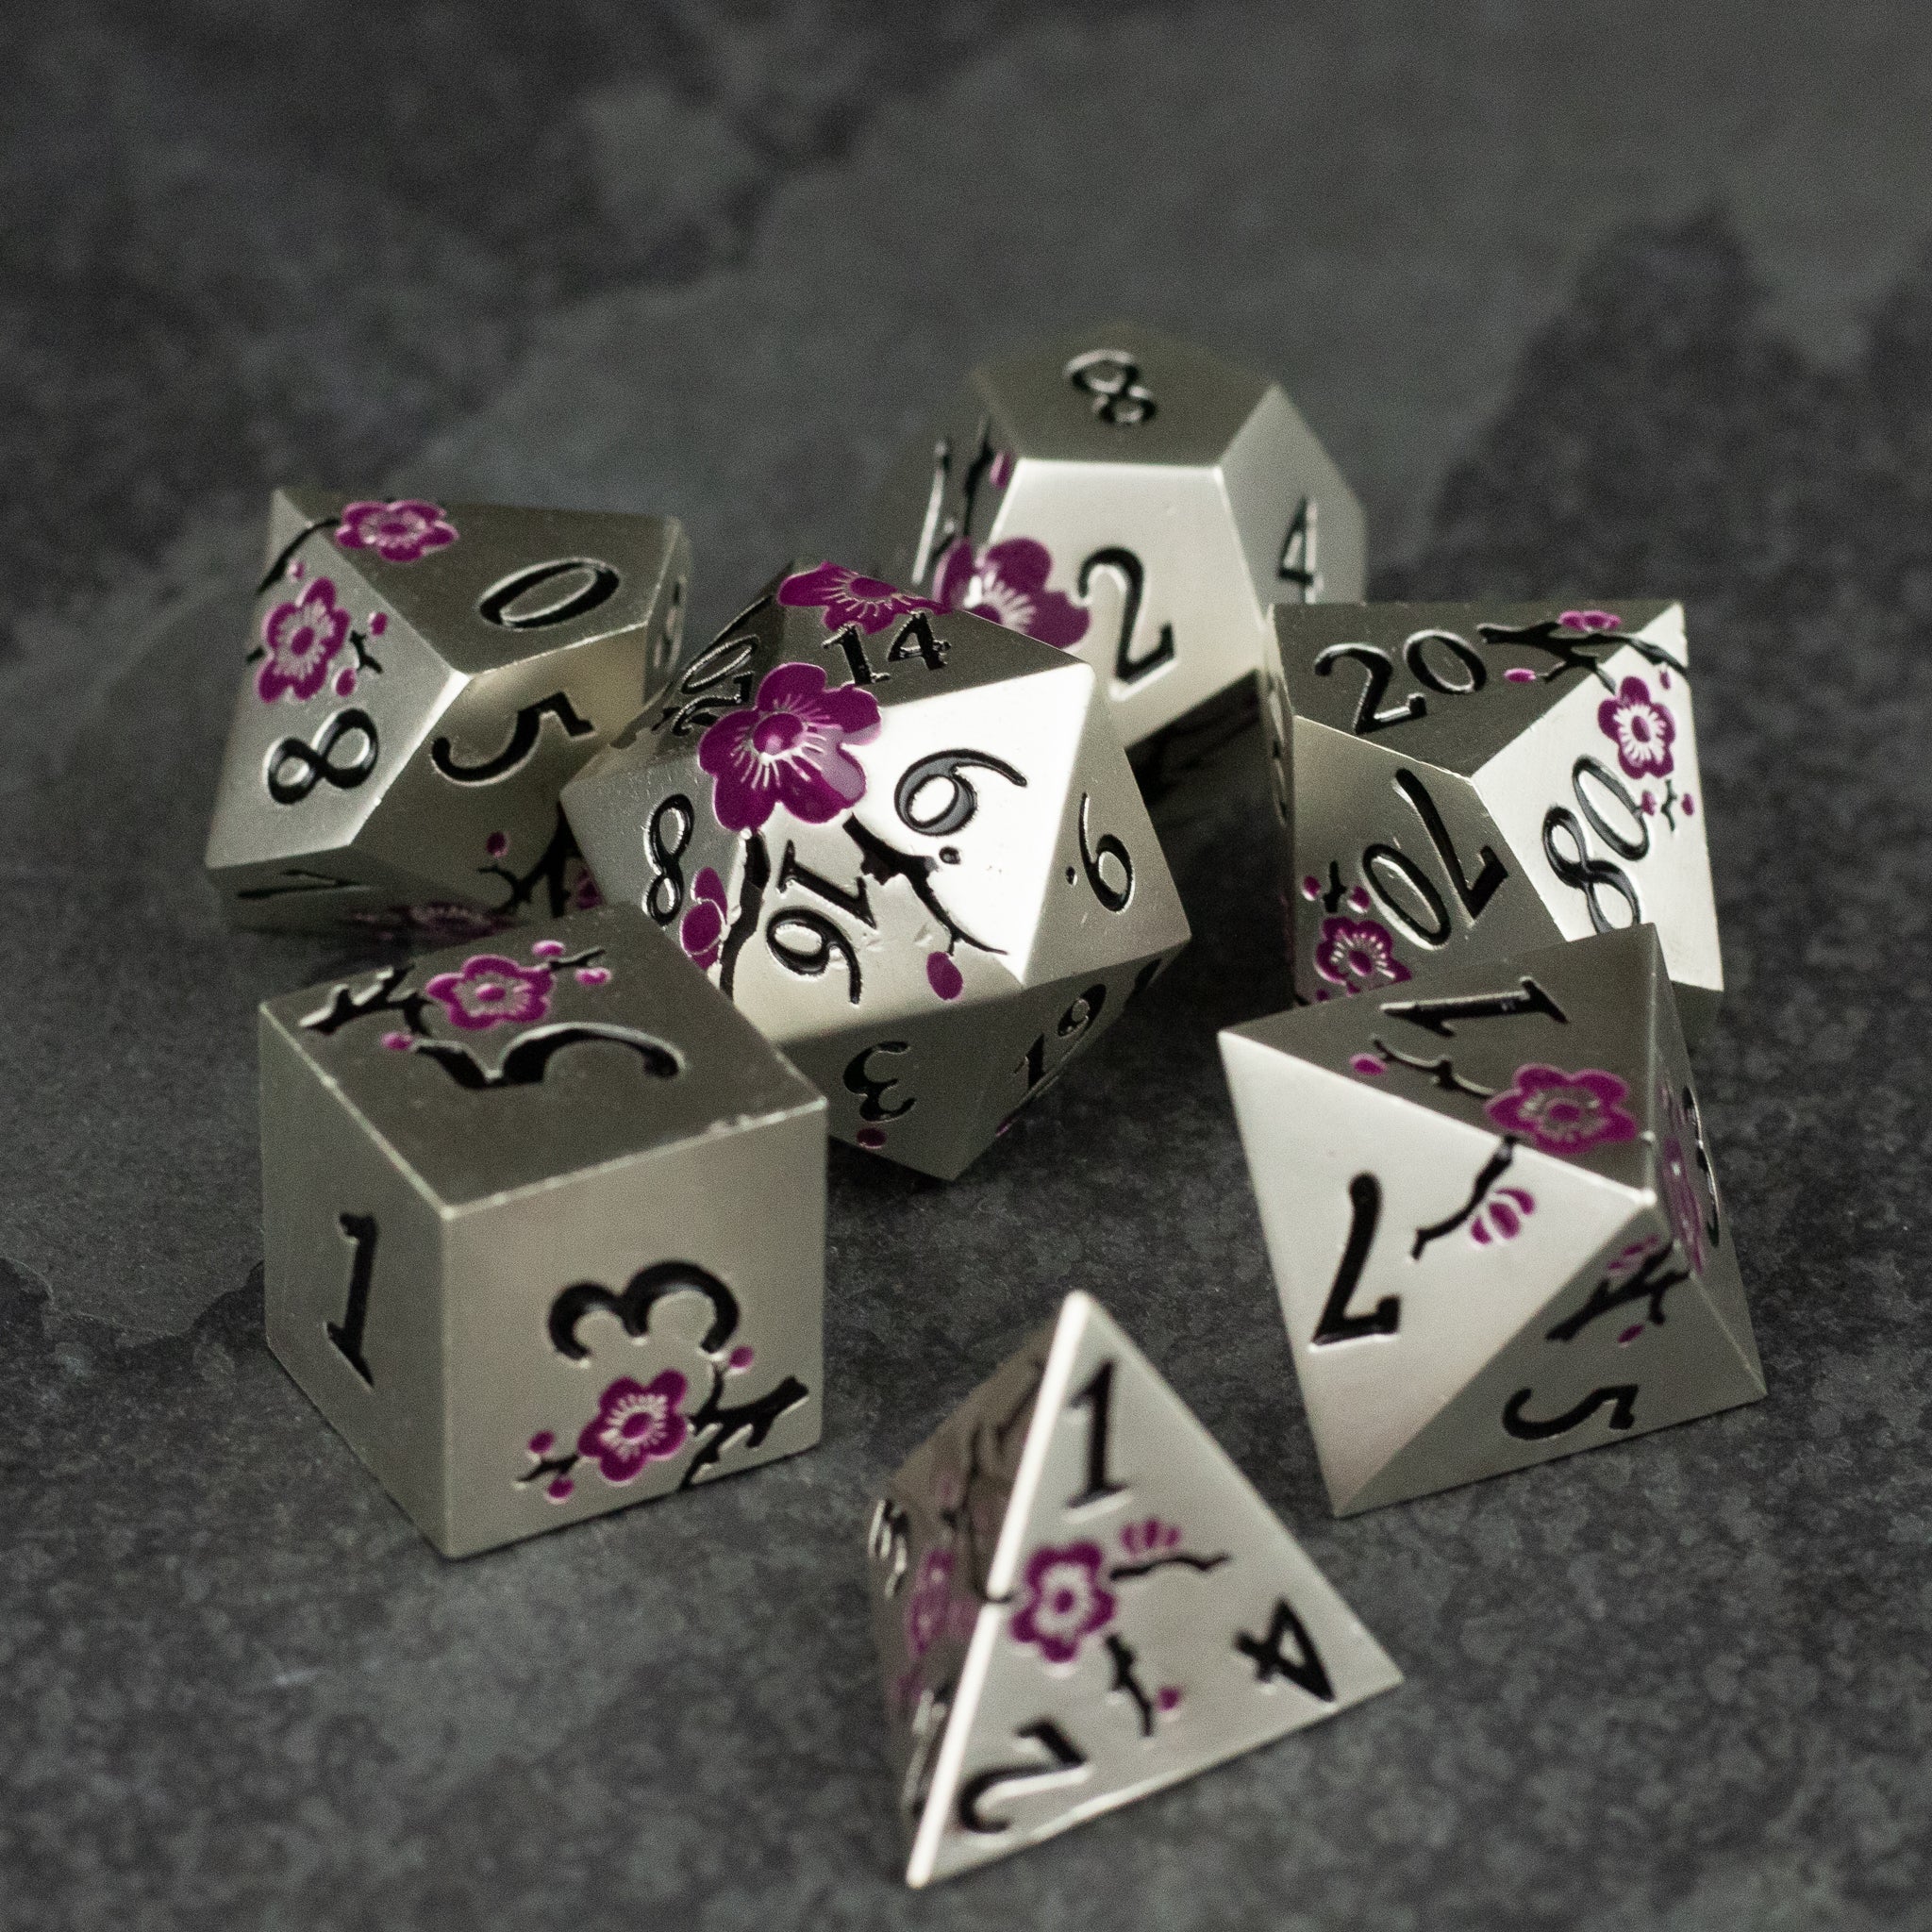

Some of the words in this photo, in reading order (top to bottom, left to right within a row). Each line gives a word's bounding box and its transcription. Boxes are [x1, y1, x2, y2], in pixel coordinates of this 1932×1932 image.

[1063, 349, 1156, 427] 8
[478, 558, 620, 629] 0
[1278, 496, 1320, 603] 4
[824, 610, 951, 686] 14
[1076, 545, 1176, 693] 2
[1315, 629, 1487, 735] 20
[264, 708, 378, 805] 8
[431, 691, 593, 786] 5
[642, 794, 693, 926] 8
[1361, 768, 1508, 949] 70
[1542, 756, 1651, 933] 80
[766, 840, 877, 1006] 16
[416, 1024, 686, 1090] 5
[1381, 976, 1568, 1037] 1
[843, 1041, 915, 1123] 3
[326, 1213, 375, 1388] 1
[1308, 1172, 1401, 1346] 7
[548, 1260, 741, 1363] 3
[1068, 1359, 1132, 1513] 1
[1502, 1384, 1639, 1440] 5
[1235, 1600, 1336, 1703] 4
[957, 1718, 1091, 1834] 2
